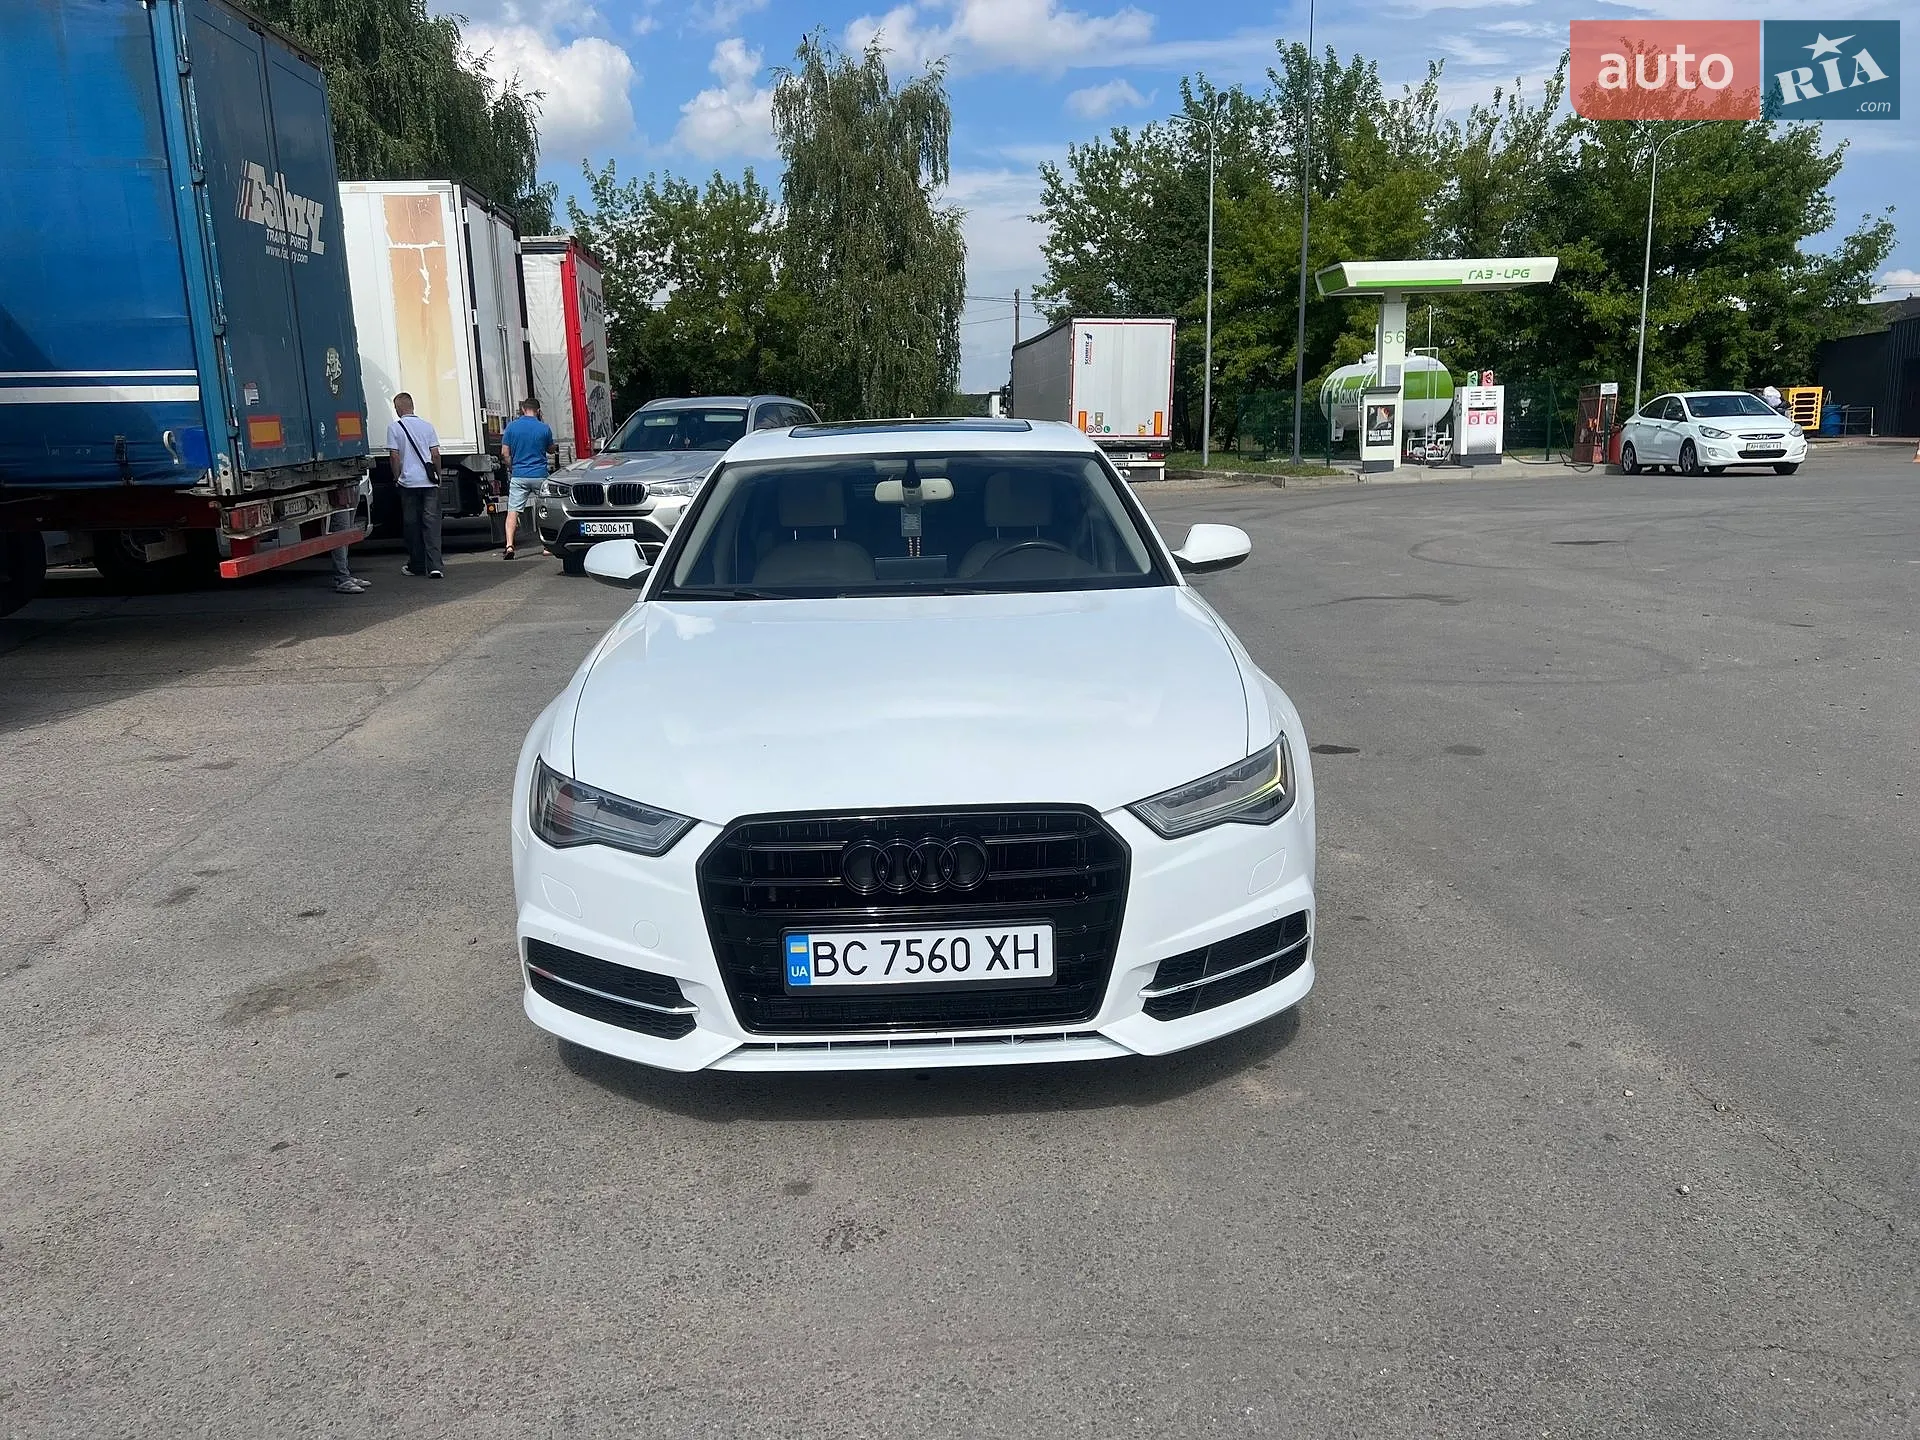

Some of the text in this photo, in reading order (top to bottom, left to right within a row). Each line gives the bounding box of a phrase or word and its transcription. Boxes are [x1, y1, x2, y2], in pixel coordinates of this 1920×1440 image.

[585, 523, 630, 533] BC 3006 MT
[812, 933, 1039, 977] BC 7560 XH
[791, 965, 808, 977] UA
